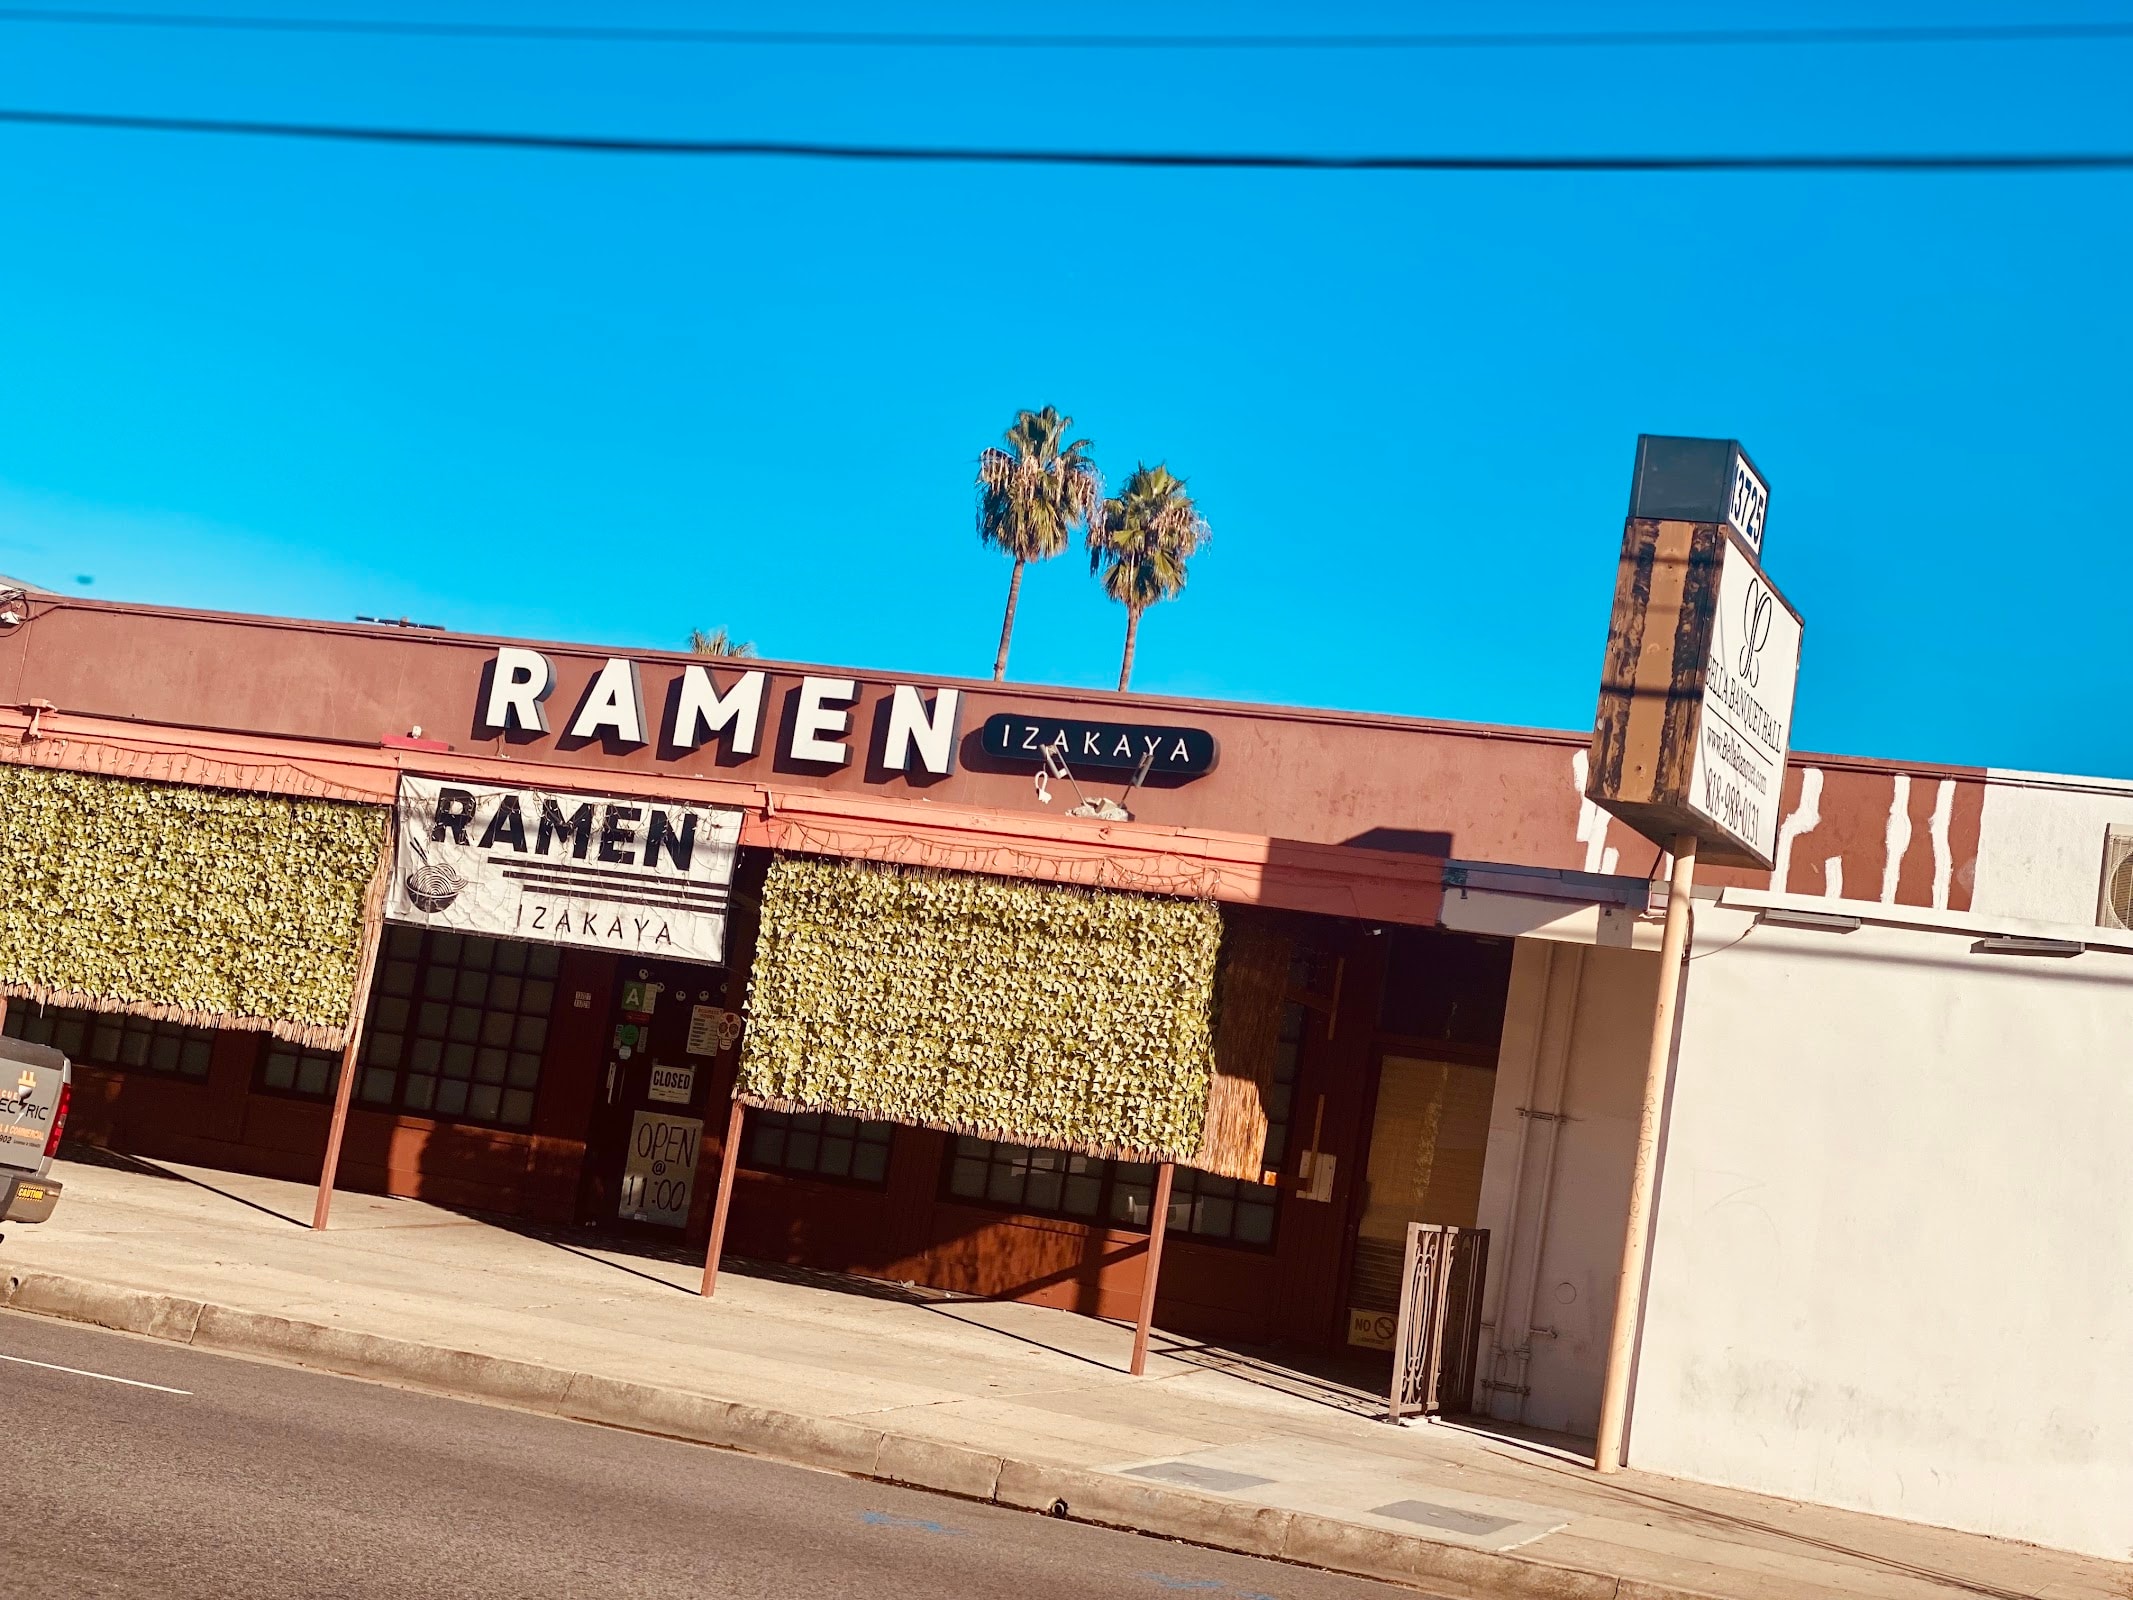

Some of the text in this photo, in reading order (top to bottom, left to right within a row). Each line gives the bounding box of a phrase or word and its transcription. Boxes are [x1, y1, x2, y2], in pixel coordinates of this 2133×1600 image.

[1731, 464, 1764, 545] 13725
[485, 647, 962, 775] RAMEN
[1706, 654, 1782, 754] BELLA BANQUET HALL
[1002, 724, 1190, 763] IZAKAYA
[1705, 767, 1760, 847] 818-988-0131
[431, 787, 698, 871] RAMEN
[516, 904, 672, 946] IZAKAYA
[625, 987, 640, 1006] A
[652, 1070, 691, 1090] CLOSED
[637, 1122, 697, 1168] OPEN
[652, 1160, 666, 1175] @
[18, 1188, 44, 1201] CAUTION
[627, 1174, 686, 1212] 11:00
[1354, 1317, 1371, 1332] NO
